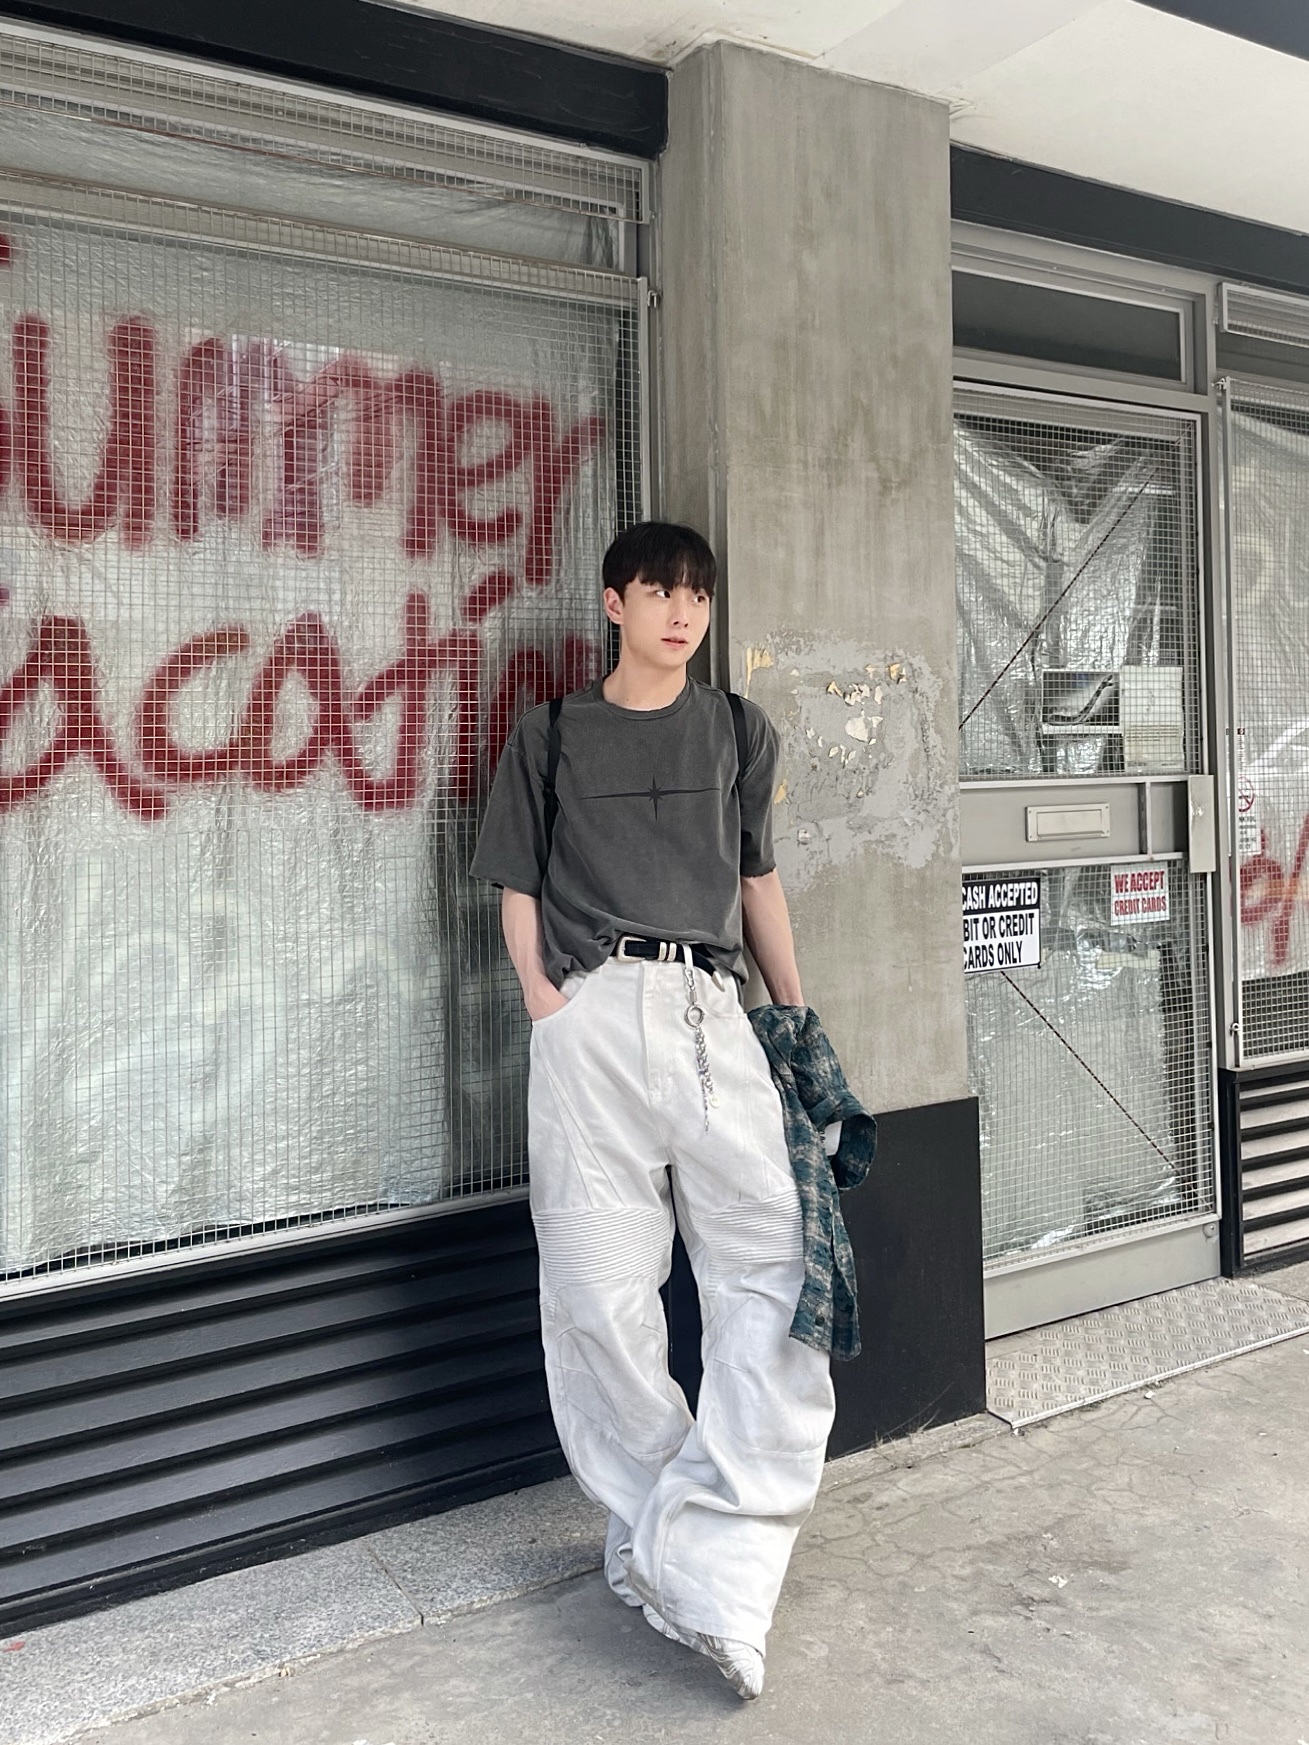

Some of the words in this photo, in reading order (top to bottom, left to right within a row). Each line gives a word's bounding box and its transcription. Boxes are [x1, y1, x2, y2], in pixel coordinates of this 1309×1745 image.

[0, 232, 604, 586] ummer
[988, 881, 1038, 909] ACCEPTED
[1114, 873, 1129, 893] WE
[1130, 870, 1165, 892] ACCEPT
[1114, 898, 1140, 916] CREDIT
[1141, 895, 1167, 913] CARDS
[982, 916, 997, 940] OR
[998, 912, 1035, 938] CREDIT
[997, 940, 1023, 966] ONLY
